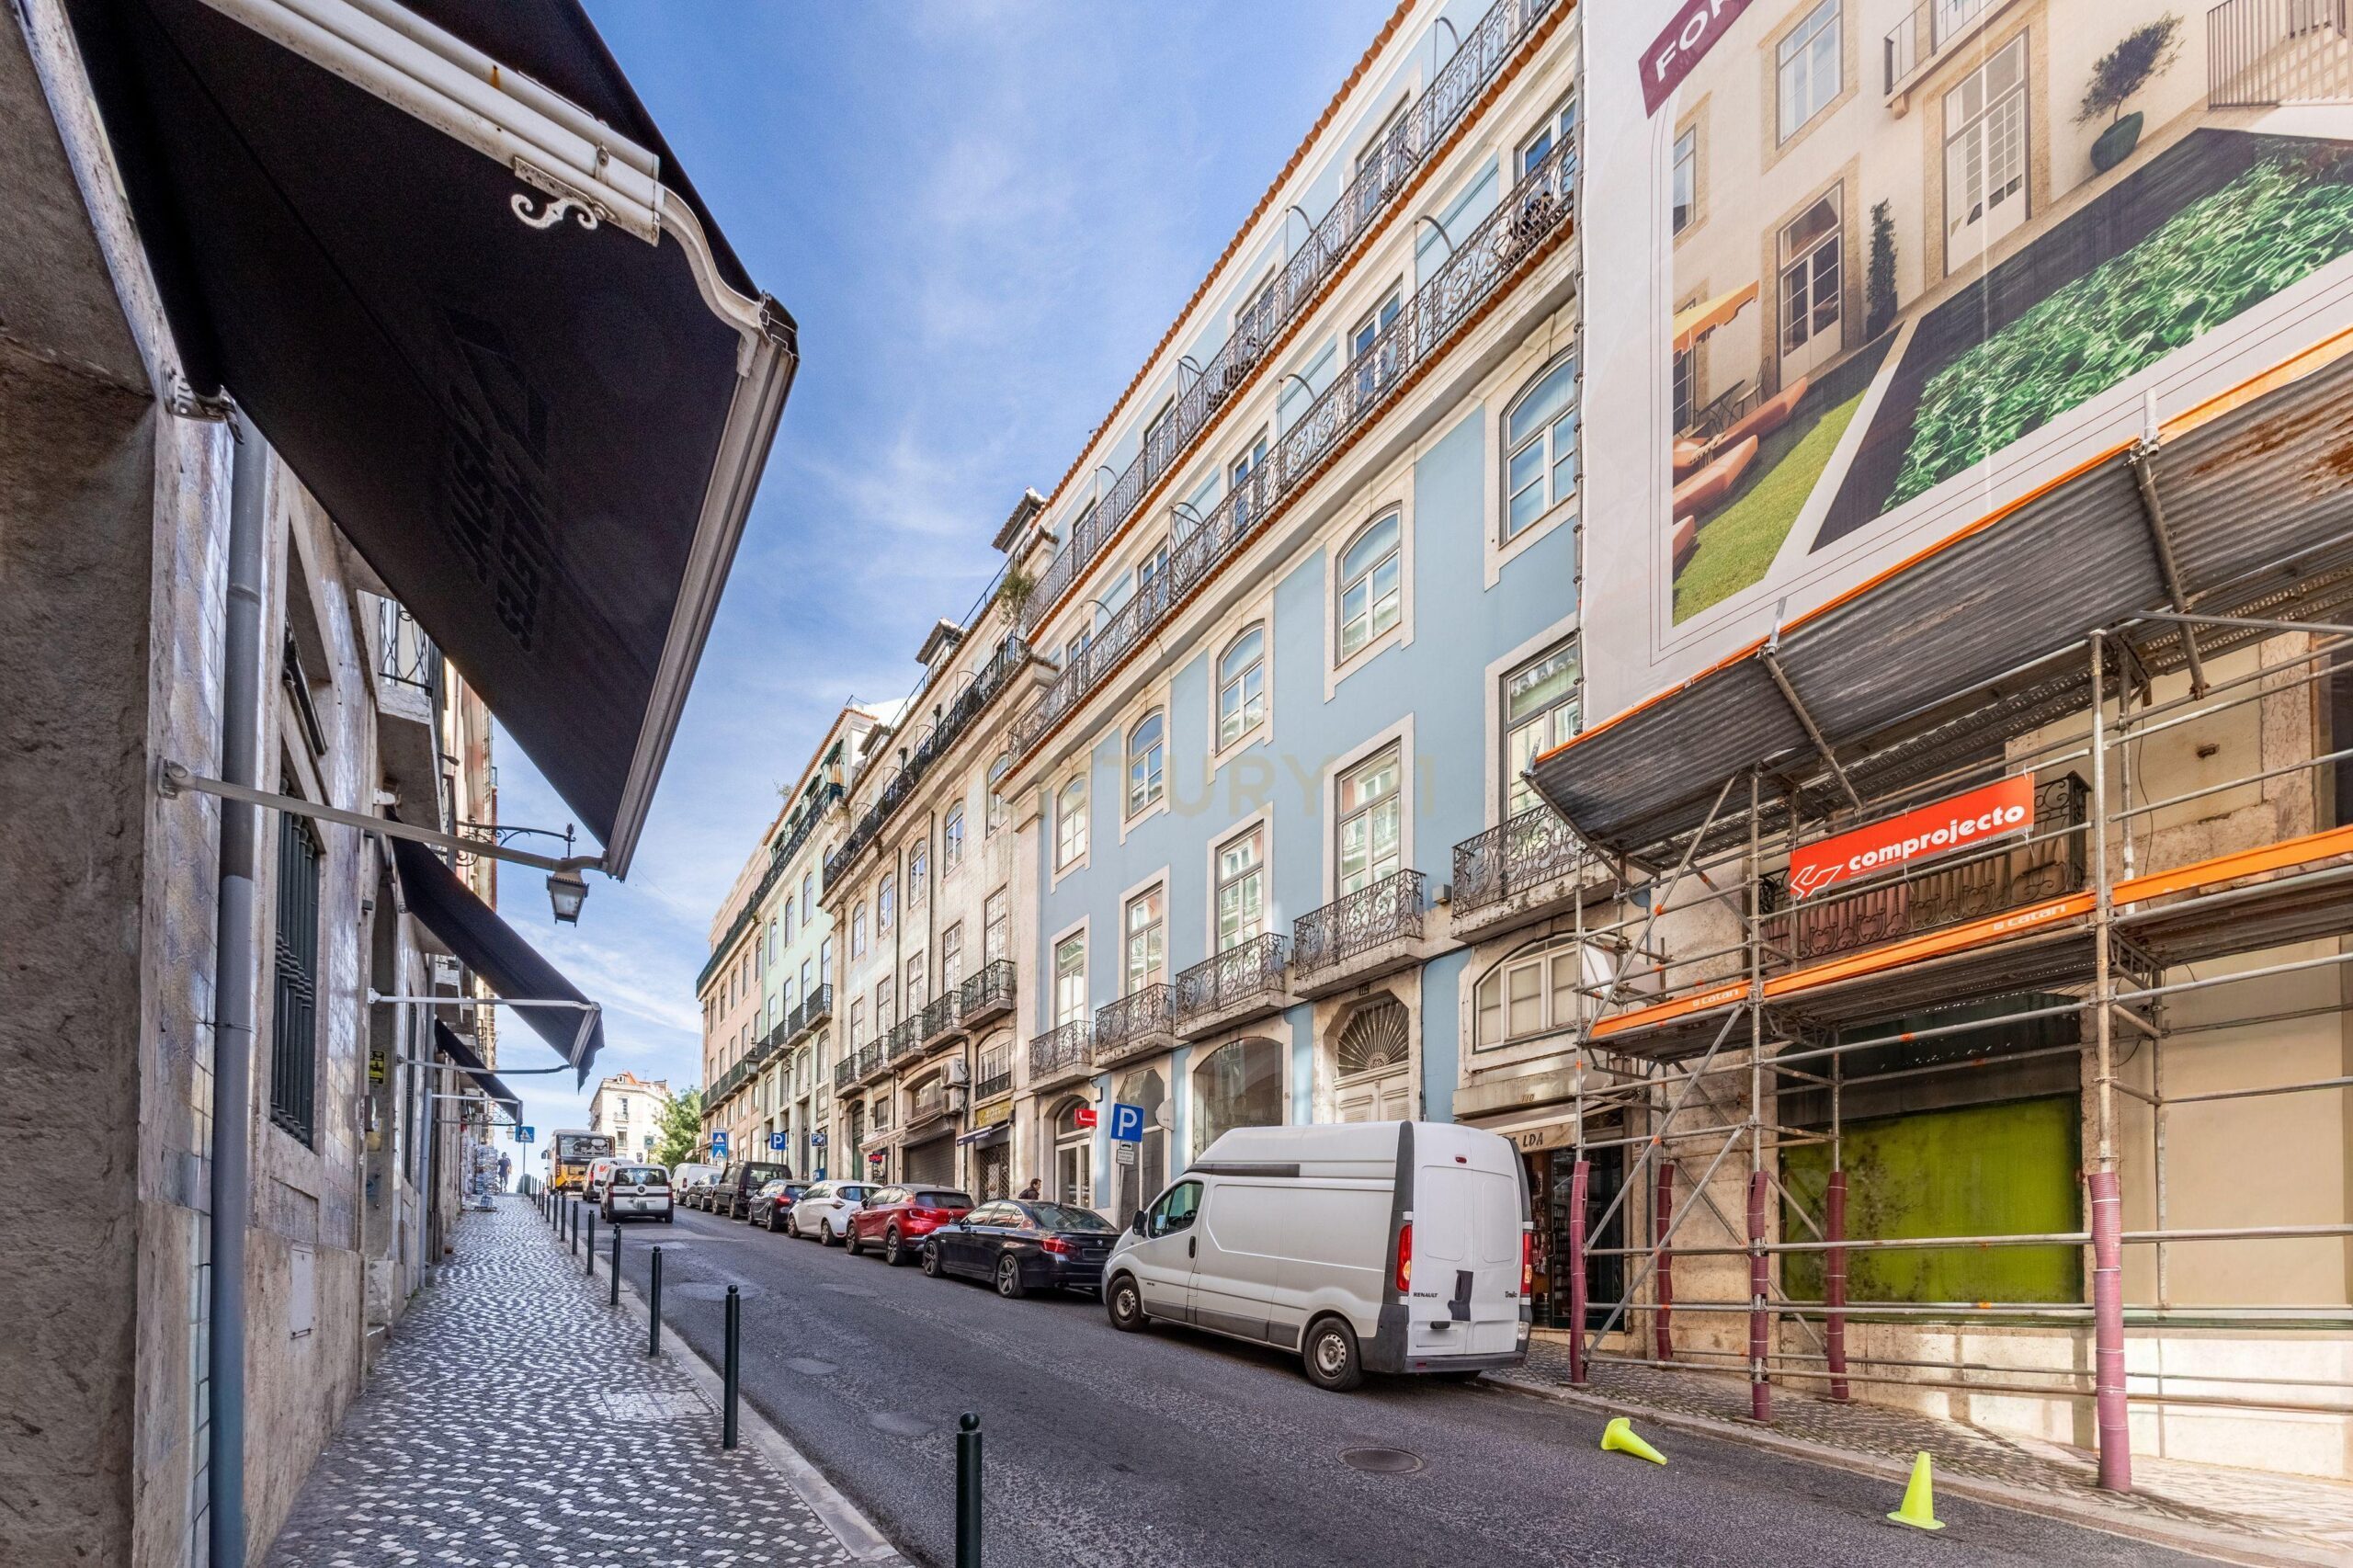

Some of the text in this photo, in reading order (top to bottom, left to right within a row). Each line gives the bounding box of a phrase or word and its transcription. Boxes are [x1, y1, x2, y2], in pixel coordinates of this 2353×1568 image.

[1848, 805, 2025, 870] comprojecto
[2007, 904, 2065, 926] catari
[1118, 1108, 1138, 1137] P
[773, 1134, 783, 1148] P
[1522, 1131, 1543, 1147] LDA
